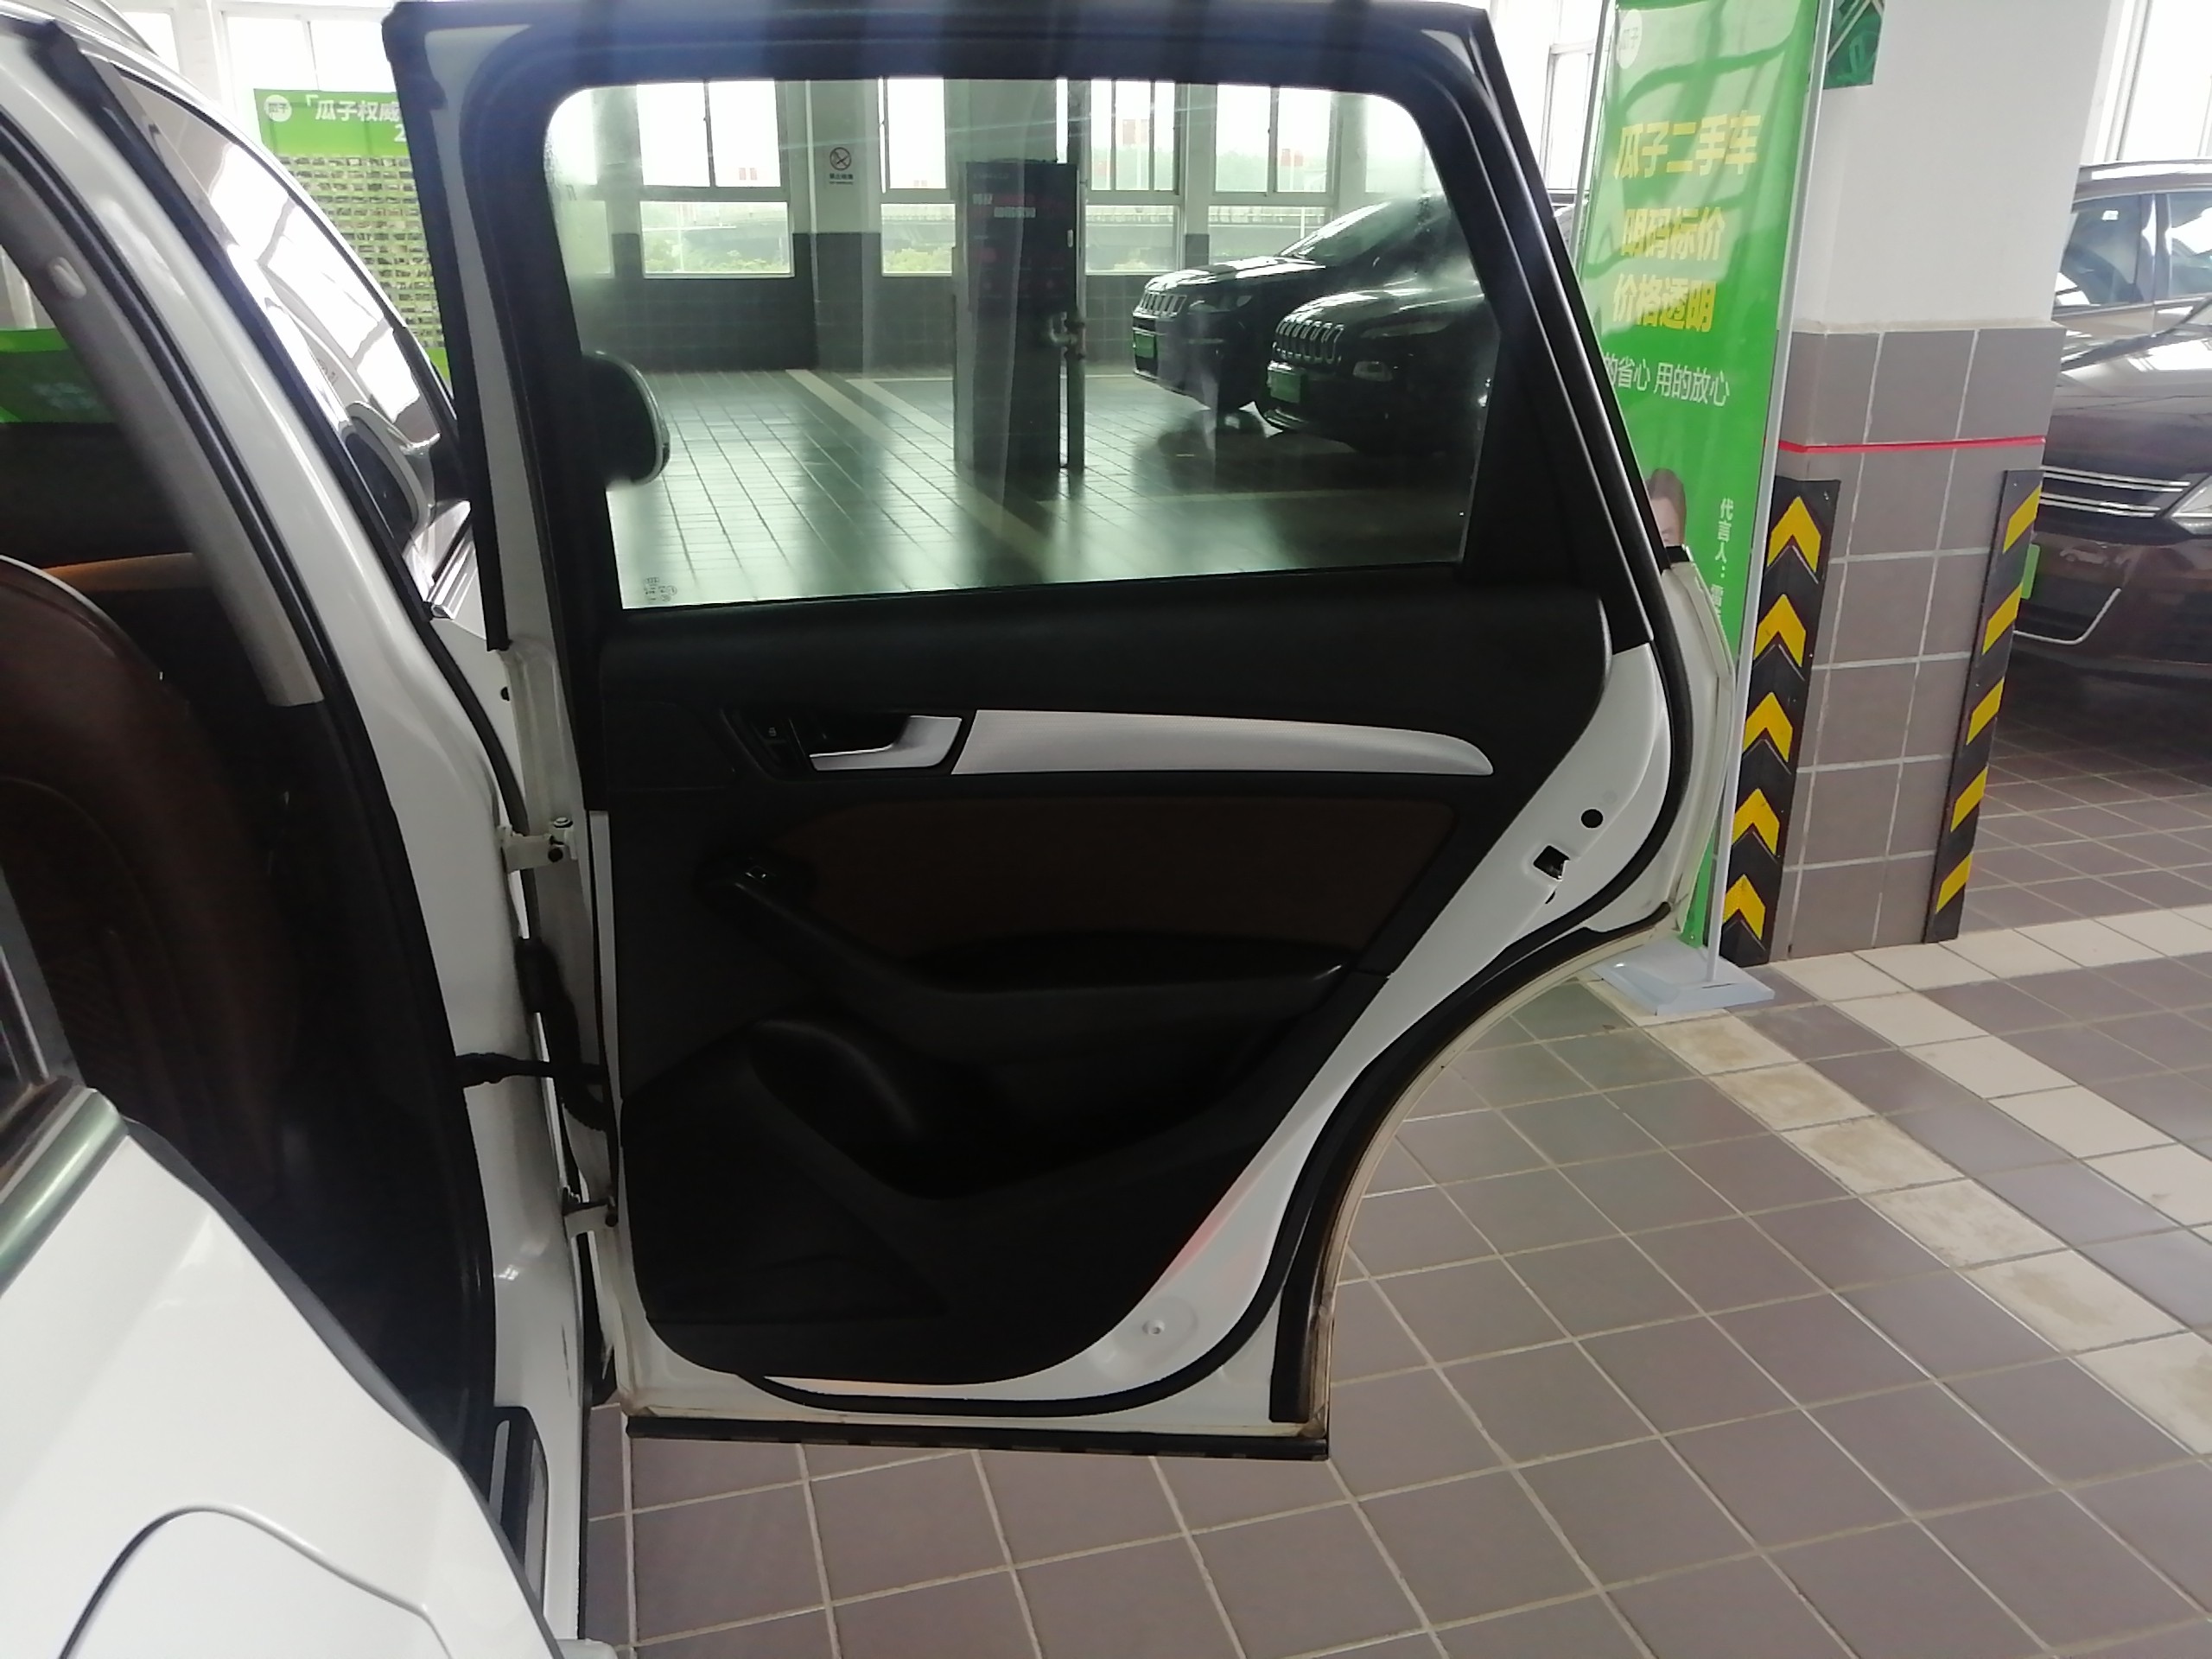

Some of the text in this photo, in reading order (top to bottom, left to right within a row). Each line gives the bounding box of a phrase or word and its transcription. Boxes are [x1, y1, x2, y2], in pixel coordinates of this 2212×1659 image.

[1613, 110, 1762, 180] 瓜子二手车
[1620, 207, 1726, 261] 明码标价
[1612, 273, 1718, 333] 价格透明
[1654, 361, 1731, 407] 用的放心
